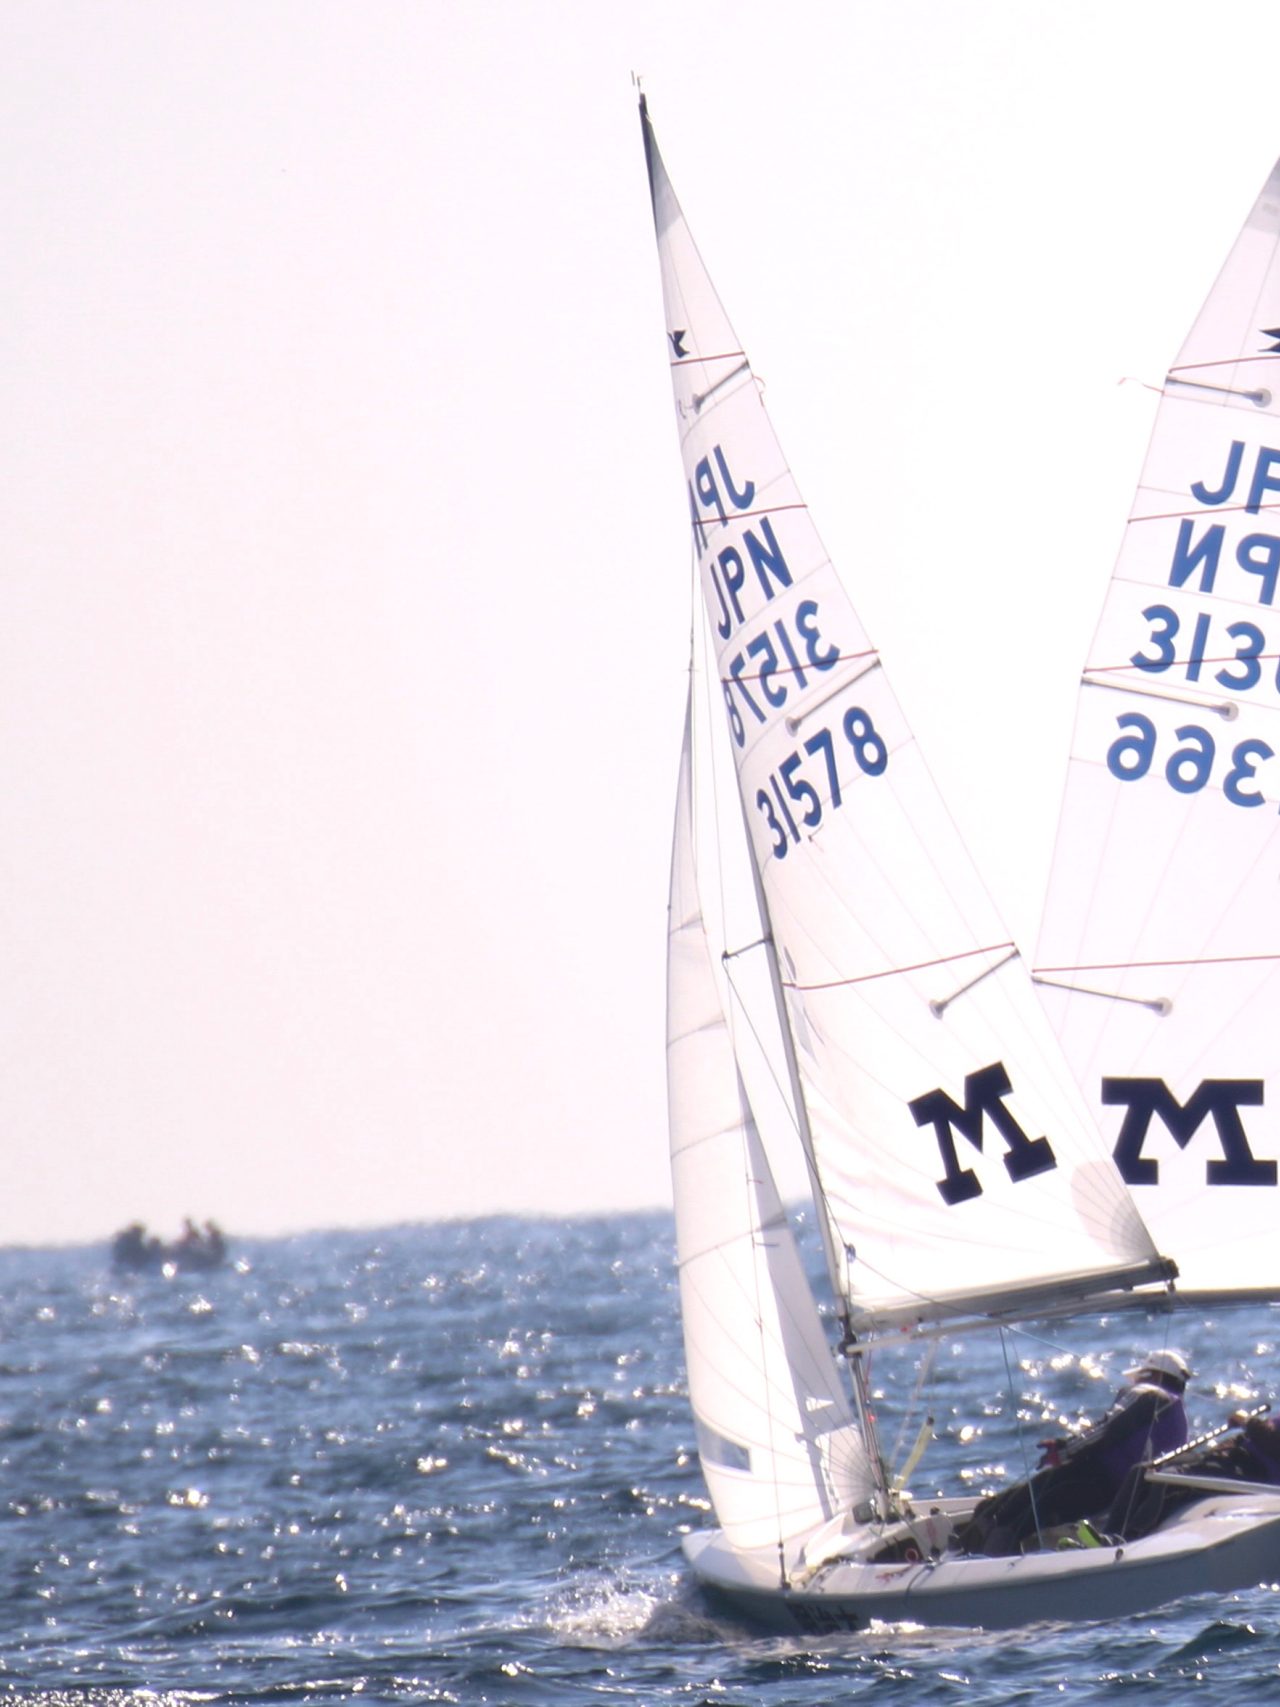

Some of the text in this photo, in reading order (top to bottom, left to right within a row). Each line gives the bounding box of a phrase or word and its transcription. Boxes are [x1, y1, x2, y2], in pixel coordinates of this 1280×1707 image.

[710, 516, 793, 640] JPN
[757, 706, 888, 859] 31578
[907, 1060, 1057, 1206] M
[1101, 1077, 1278, 1186] M
